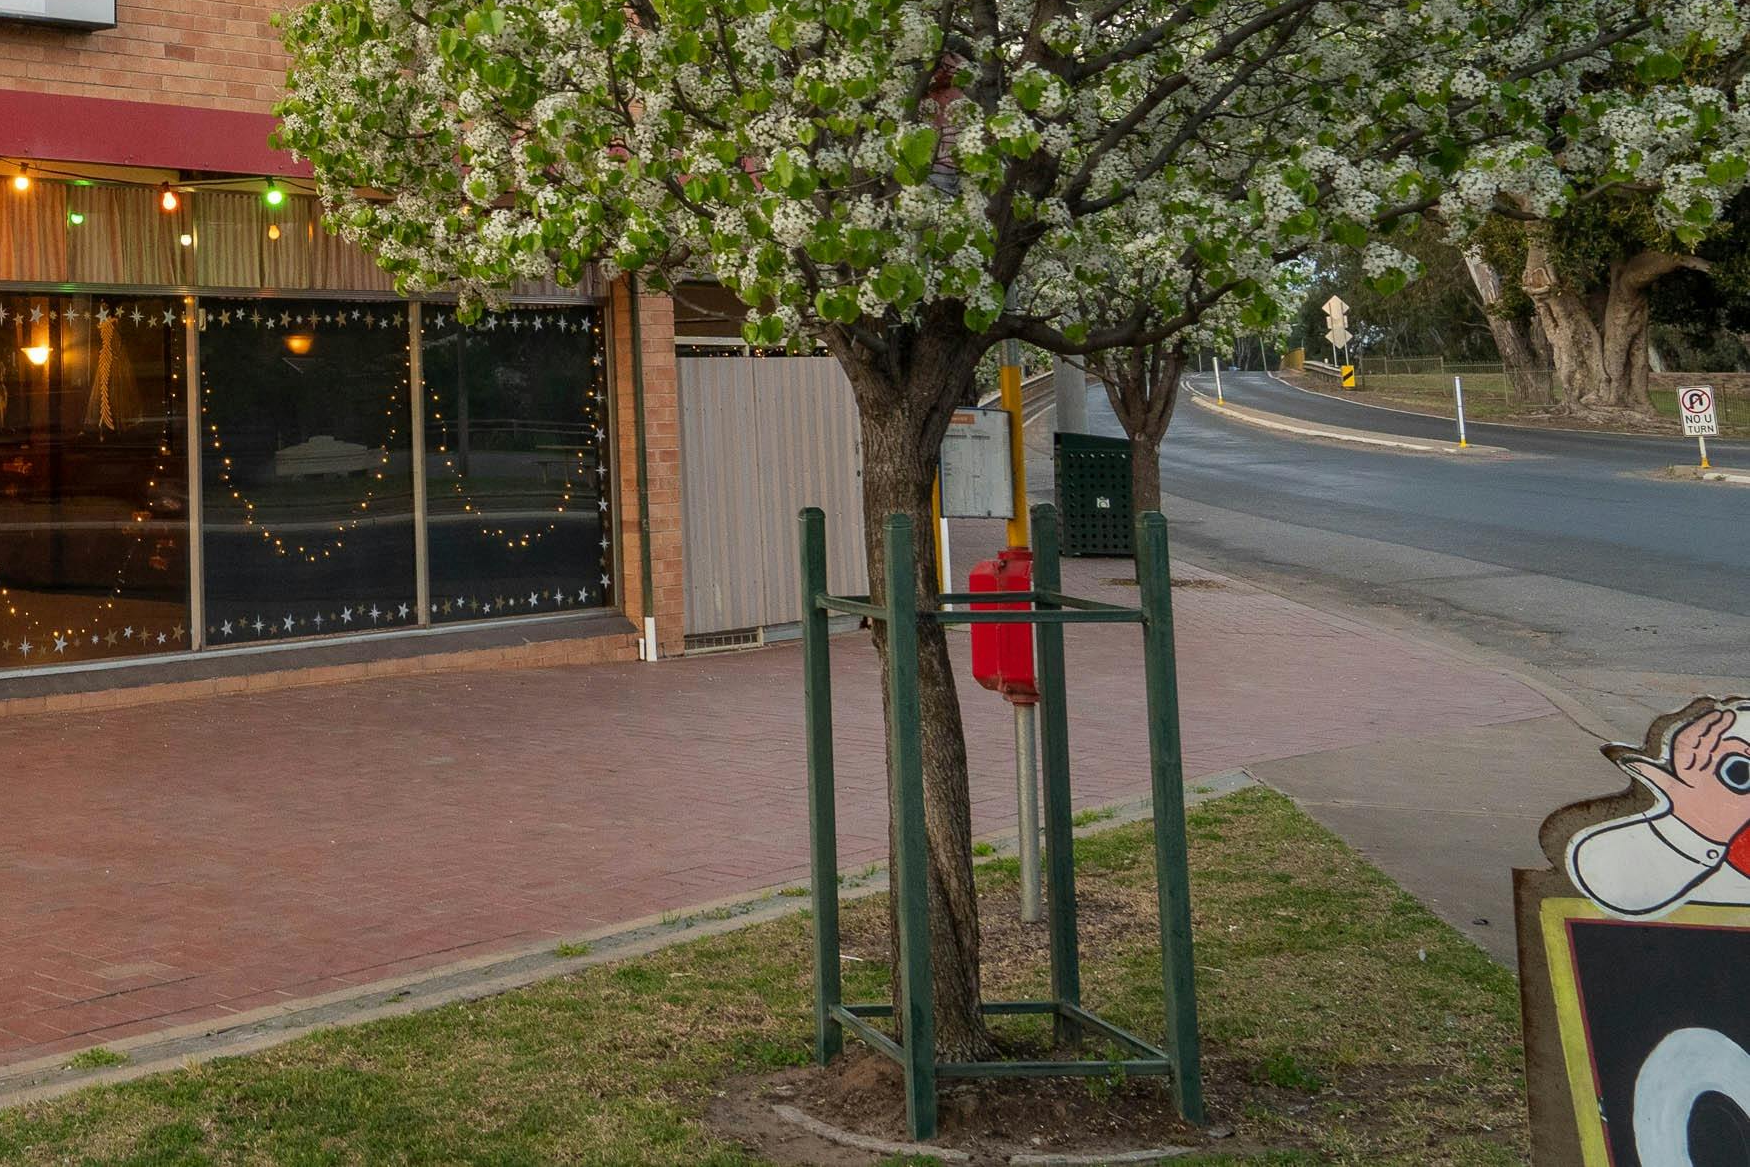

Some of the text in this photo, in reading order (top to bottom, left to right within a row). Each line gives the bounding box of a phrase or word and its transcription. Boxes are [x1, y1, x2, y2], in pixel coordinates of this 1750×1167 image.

[1685, 414, 1712, 424] NO U
[1687, 425, 1714, 434] TURN
